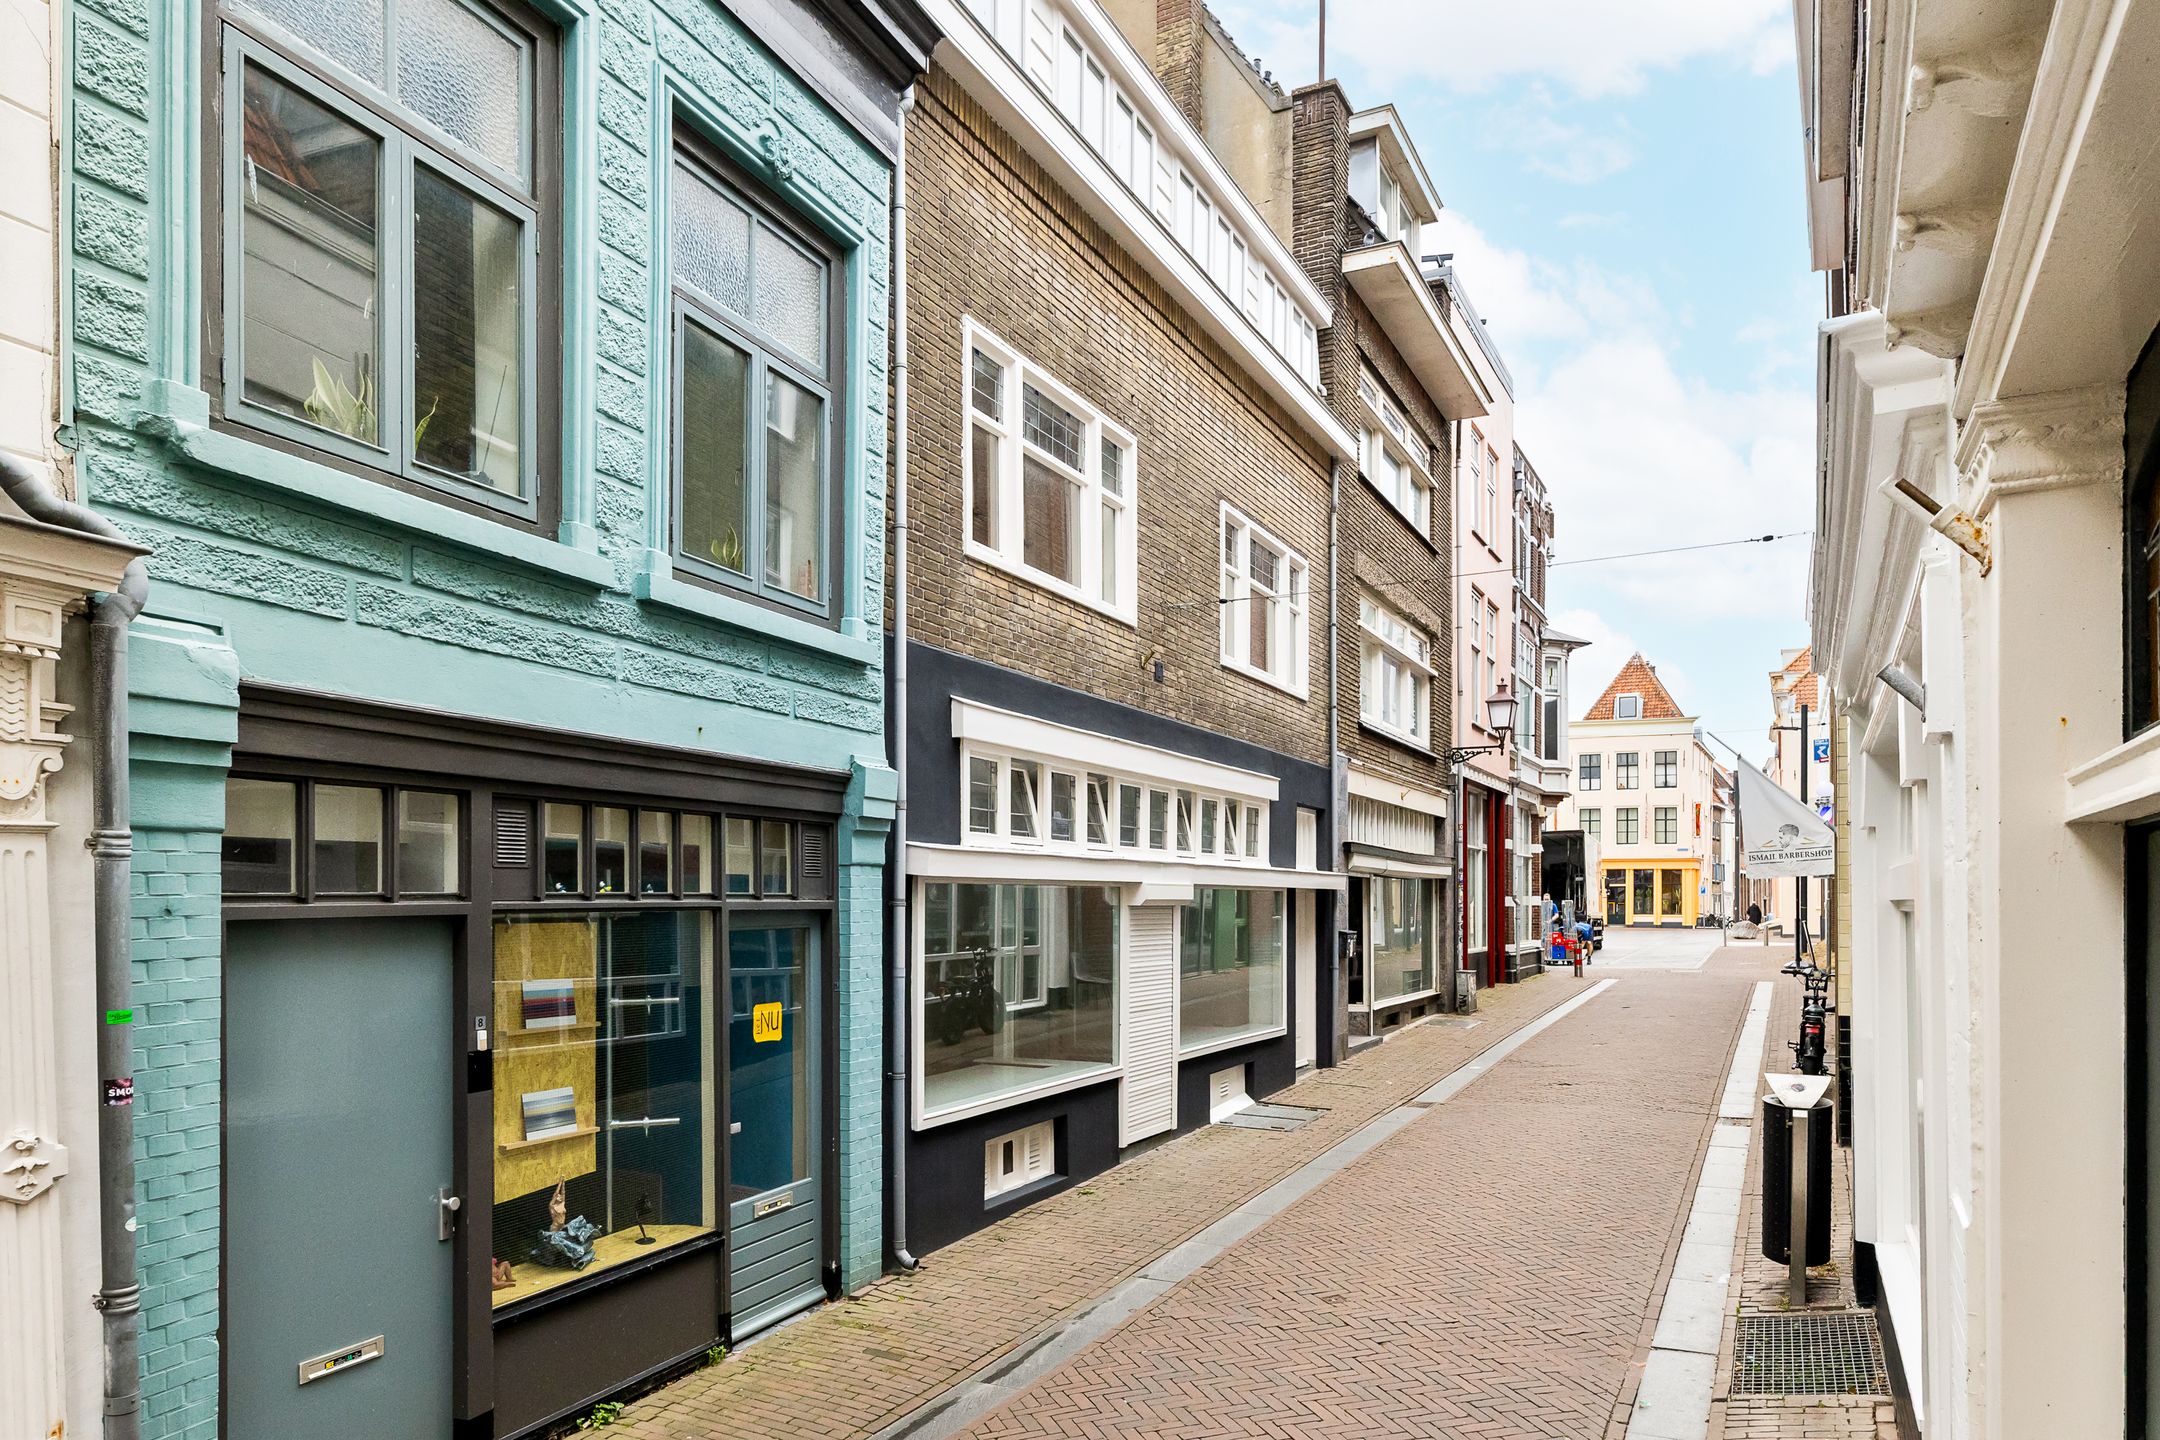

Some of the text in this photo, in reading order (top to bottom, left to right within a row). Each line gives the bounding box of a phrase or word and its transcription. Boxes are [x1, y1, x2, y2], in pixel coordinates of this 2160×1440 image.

[1748, 849, 1833, 862] ISMAIL BARBERSHOP
[477, 1018, 483, 1028] 8
[760, 1010, 780, 1035] NU
